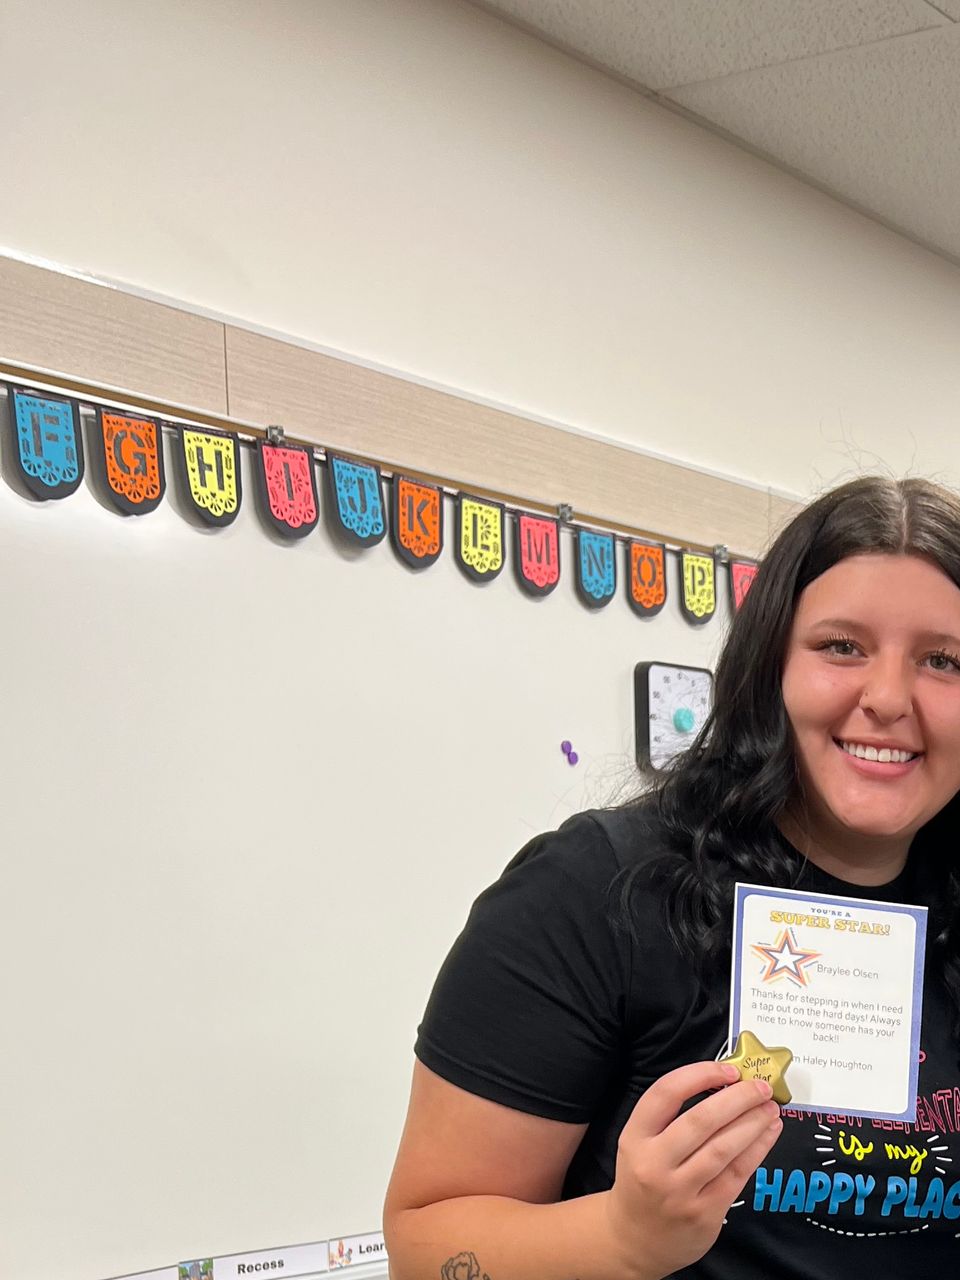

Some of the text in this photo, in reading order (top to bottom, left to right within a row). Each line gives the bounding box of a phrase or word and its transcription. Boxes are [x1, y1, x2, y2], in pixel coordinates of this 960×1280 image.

[30, 411, 60, 457] F
[114, 430, 148, 477] G
[195, 446, 225, 491] H
[282, 462, 294, 501] I
[347, 477, 368, 514] J
[407, 495, 430, 538] K
[471, 513, 490, 551] L
[526, 528, 551, 566] M
[586, 543, 606, 579] N
[637, 554, 657, 588] O
[690, 564, 706, 596] P
[770, 911, 891, 936] SUPER STAR!
[816, 964, 879, 979] Braylee Olsen
[751, 988, 784, 1000] Thanks
[786, 992, 799, 1002] for
[800, 995, 839, 1009] stepping
[841, 1000, 849, 1008] in
[851, 1001, 875, 1011] when
[882, 1005, 903, 1014] need
[757, 1014, 896, 1038] nice to know someone has your
[759, 1002, 774, 1012] tap
[776, 1004, 791, 1013] out
[793, 1007, 805, 1015] on
[807, 1008, 821, 1017] the
[823, 1010, 843, 1020] hard
[845, 1012, 868, 1022] days!
[870, 1015, 901, 1027] Always
[813, 1033, 840, 1043] back!!
[743, 1057, 771, 1073] Super
[803, 1055, 828, 1068] Haley
[830, 1057, 873, 1072] Houghton
[839, 1131, 928, 1174] is my
[753, 1166, 876, 1216] HAPPY
[237, 1257, 285, 1275] Recess
